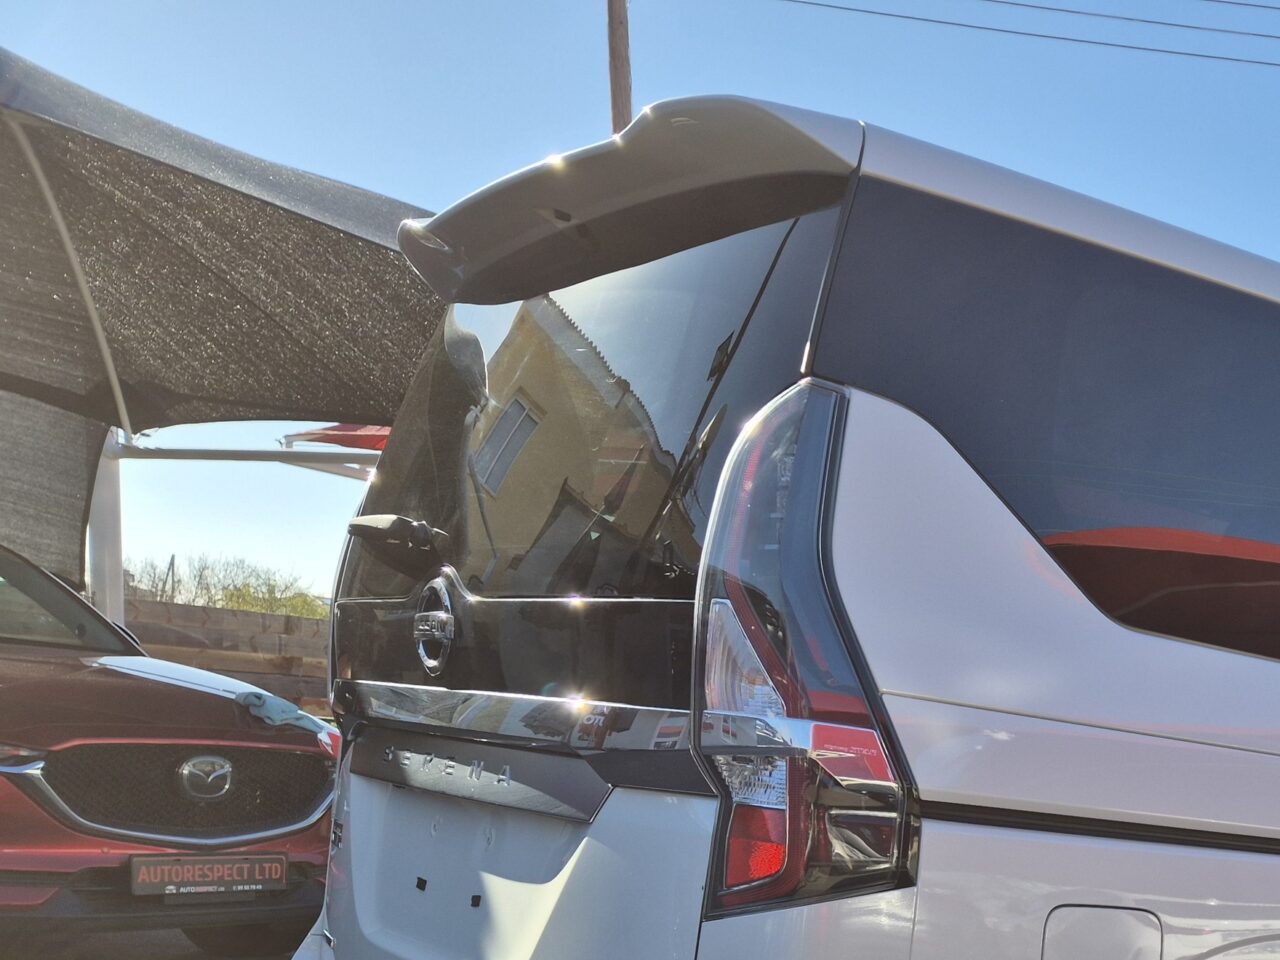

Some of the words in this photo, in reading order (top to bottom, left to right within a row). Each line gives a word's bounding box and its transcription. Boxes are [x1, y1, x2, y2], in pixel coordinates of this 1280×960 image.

[383, 746, 511, 786] SERENA
[137, 863, 250, 883] AUTORESPECT
[255, 863, 281, 880] LTD
